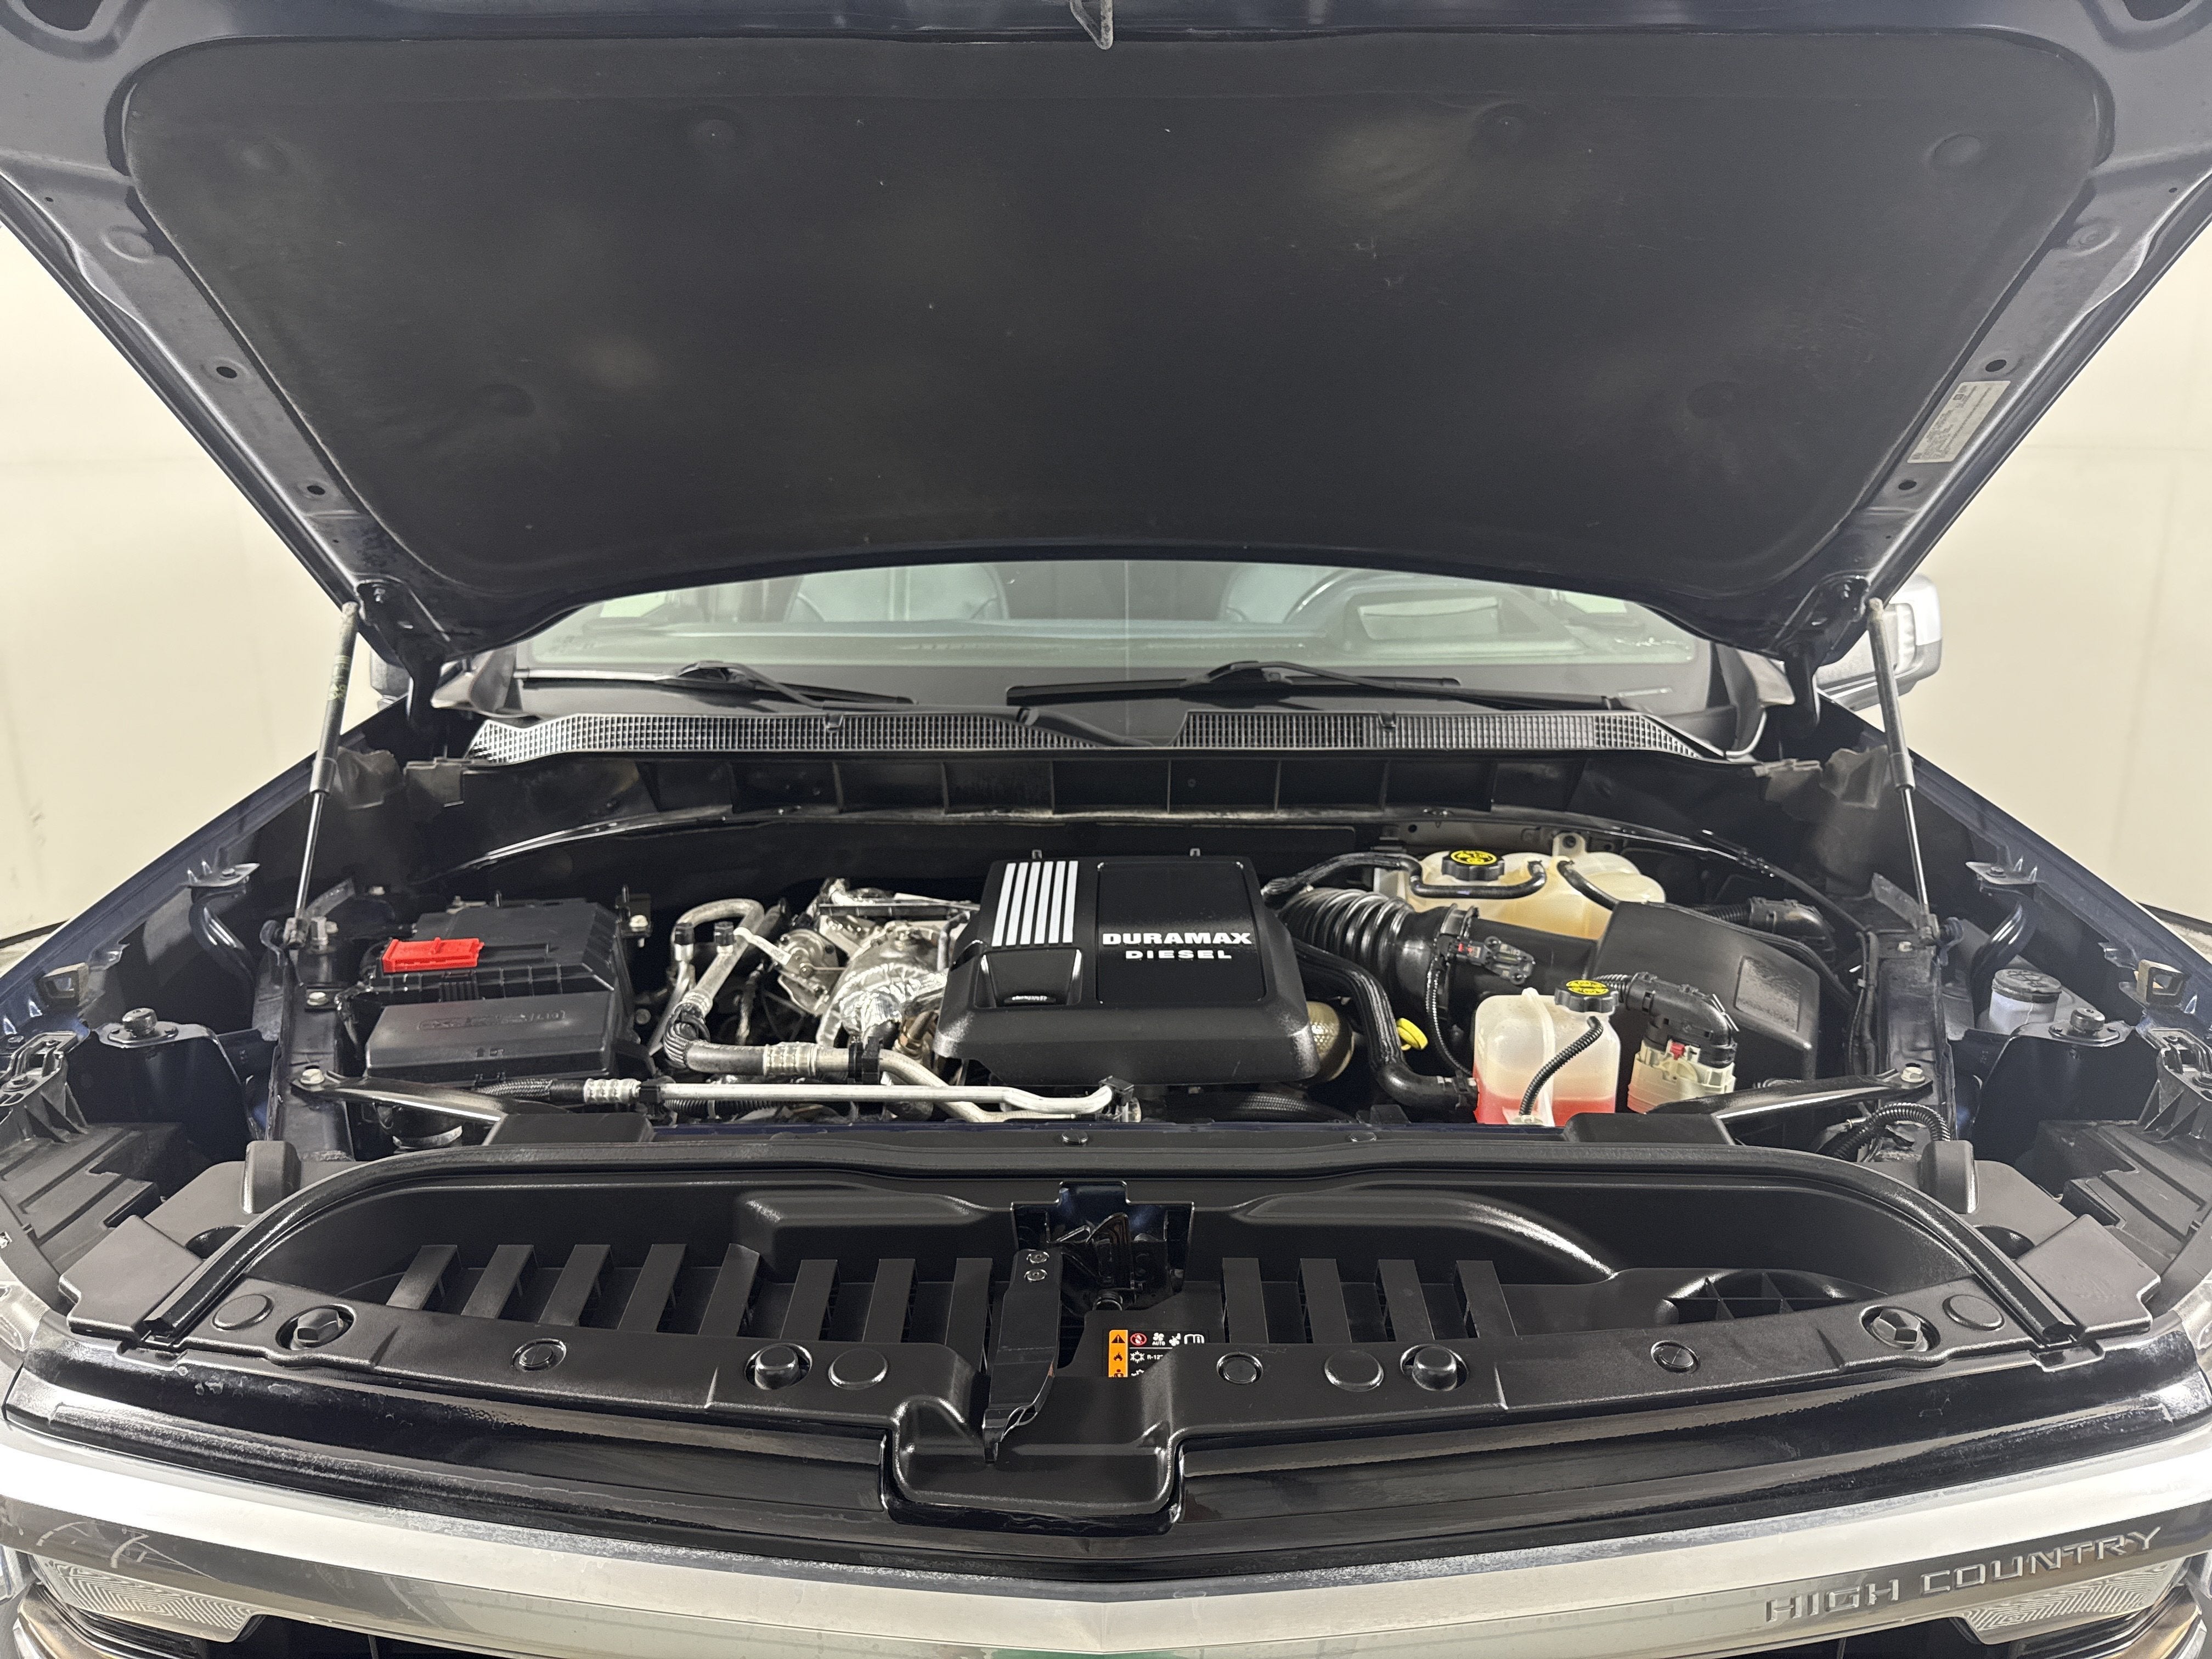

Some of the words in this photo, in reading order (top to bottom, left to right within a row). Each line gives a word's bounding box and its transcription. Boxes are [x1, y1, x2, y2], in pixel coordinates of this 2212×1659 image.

[1103, 933, 1251, 945] DURAMAX
[1126, 950, 1232, 959] DIESEL
[1766, 1579, 1899, 1622] HIGH
[1921, 1527, 2161, 1594] COUNTRY
